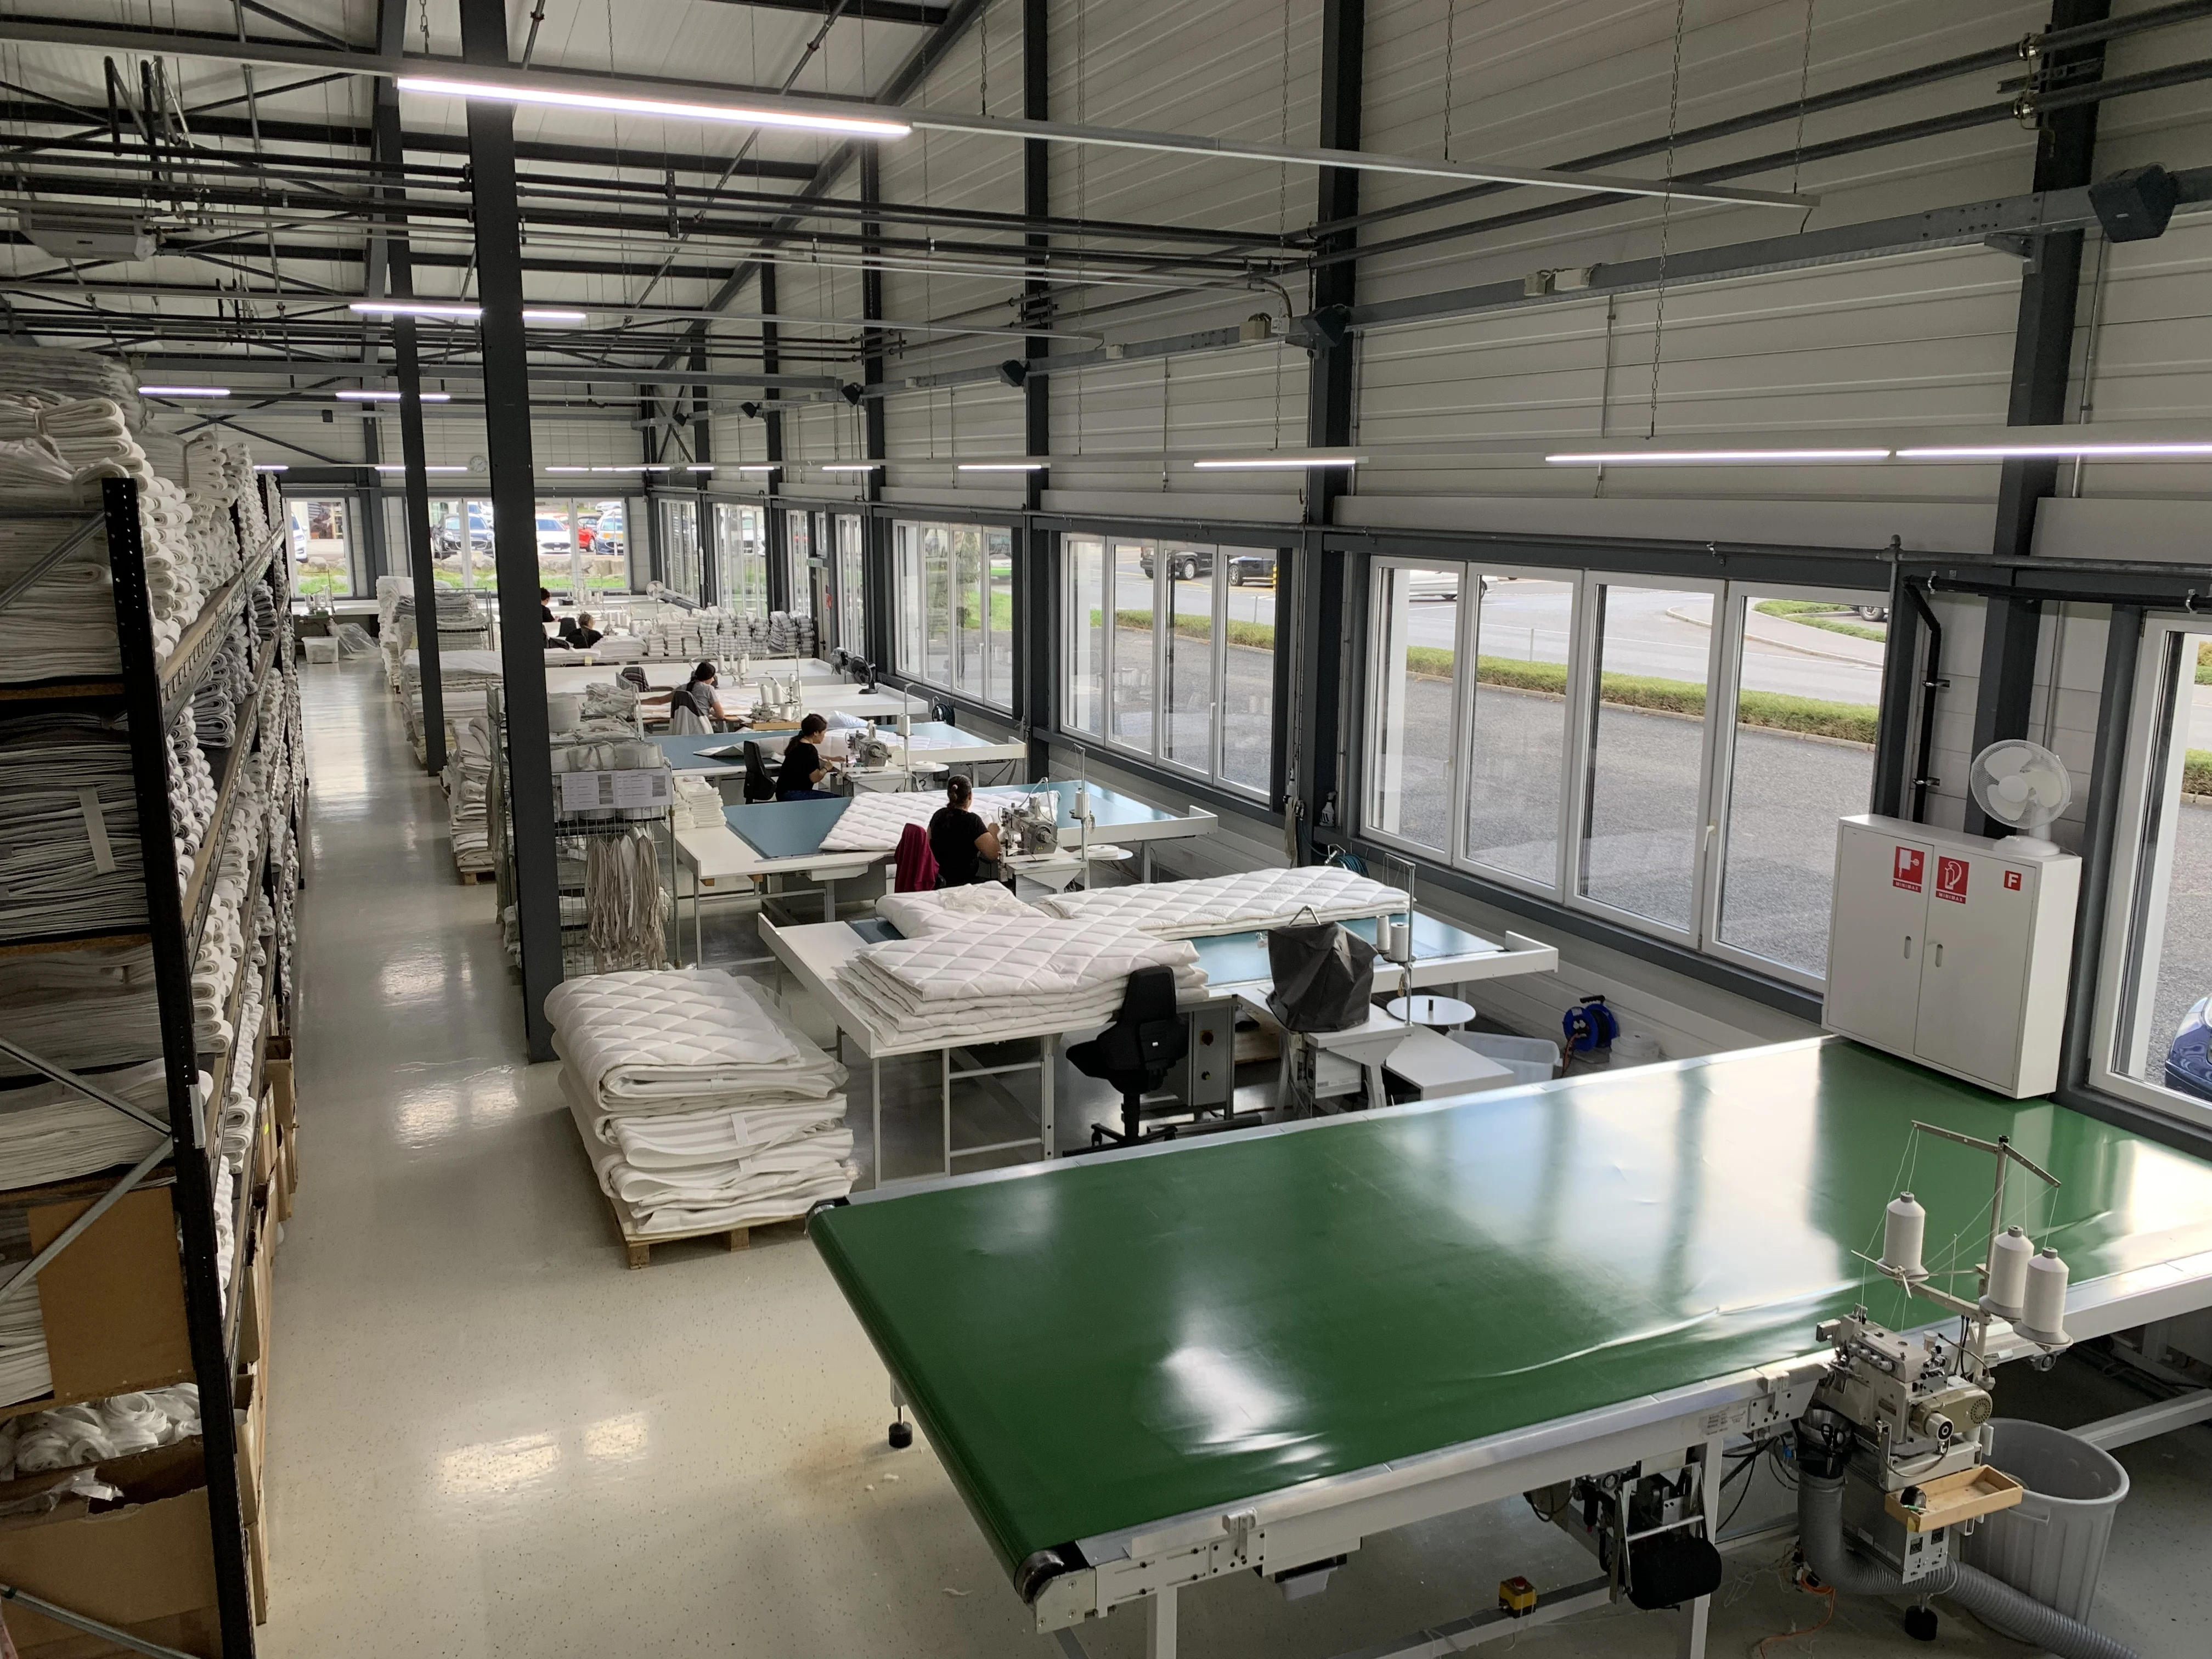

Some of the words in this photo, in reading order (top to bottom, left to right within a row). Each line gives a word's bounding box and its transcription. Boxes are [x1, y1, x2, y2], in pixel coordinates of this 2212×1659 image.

[2008, 873, 2019, 887] F
[1895, 881, 1918, 891] MINIMAX
[1938, 892, 1963, 902] MINIMAX
